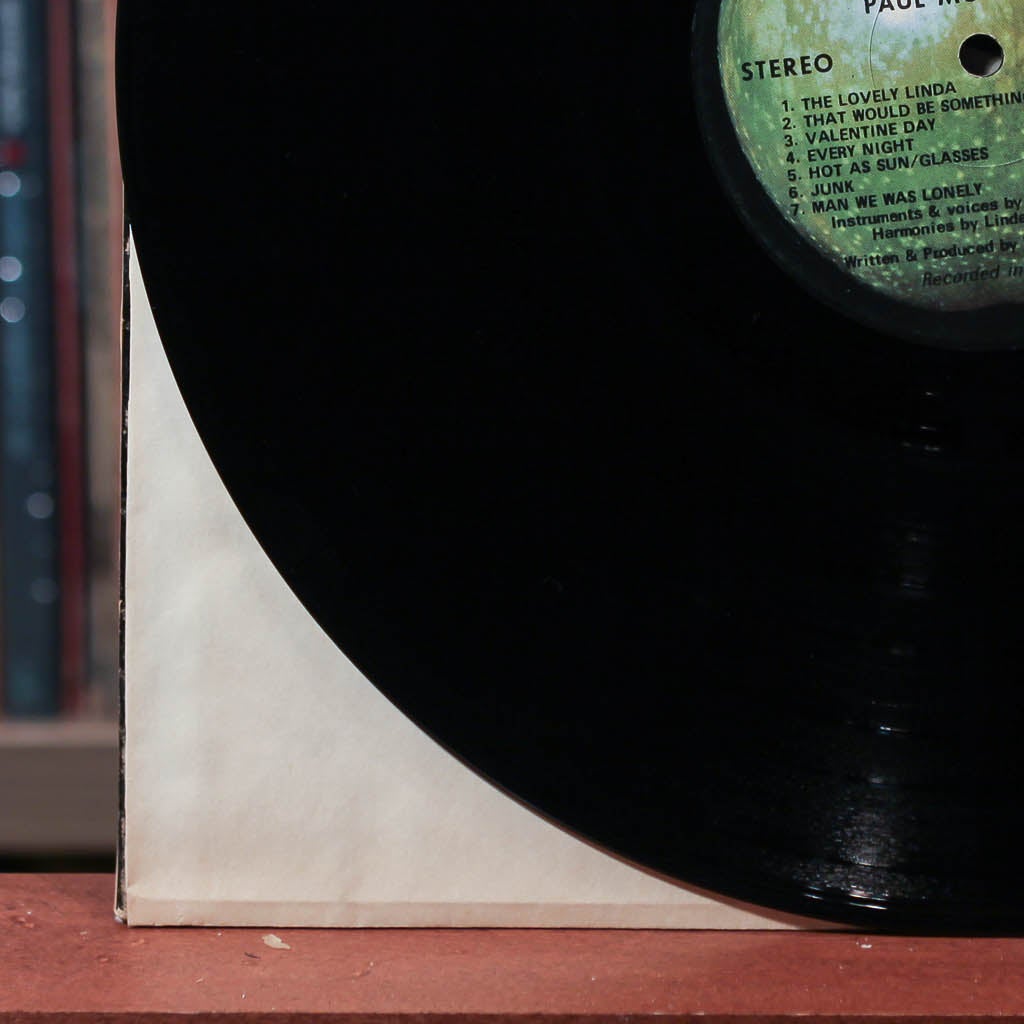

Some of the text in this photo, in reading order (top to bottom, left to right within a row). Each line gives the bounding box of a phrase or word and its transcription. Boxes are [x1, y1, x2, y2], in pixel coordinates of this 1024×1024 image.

[741, 53, 833, 81] STEREO
[782, 81, 957, 112] 1. THE LOVELY LINDA
[782, 117, 796, 130] 2.
[803, 111, 846, 128] THAT
[852, 104, 910, 122] WOULD
[917, 101, 935, 115] BE
[784, 118, 936, 148] 3. VALENTINE DAY
[786, 138, 915, 165] 4. EVERY NIGHT
[787, 147, 989, 182] 5. HOT AS SUN/GLASSES
[788, 180, 855, 199] 6. JUNK
[790, 182, 984, 217] 7. MAN WE WAS LONELY
[831, 208, 923, 229] Instruments
[928, 205, 941, 218] &
[946, 199, 999, 217] voices
[1003, 196, 1022, 211] by
[872, 221, 955, 241] Harmonies
[960, 217, 978, 233] by
[844, 253, 900, 269] Written
[905, 249, 918, 263] &
[923, 240, 994, 260] Produced
[999, 238, 1018, 253] by
[922, 265, 1000, 287] Recorded
[1007, 265, 1024, 277] in
